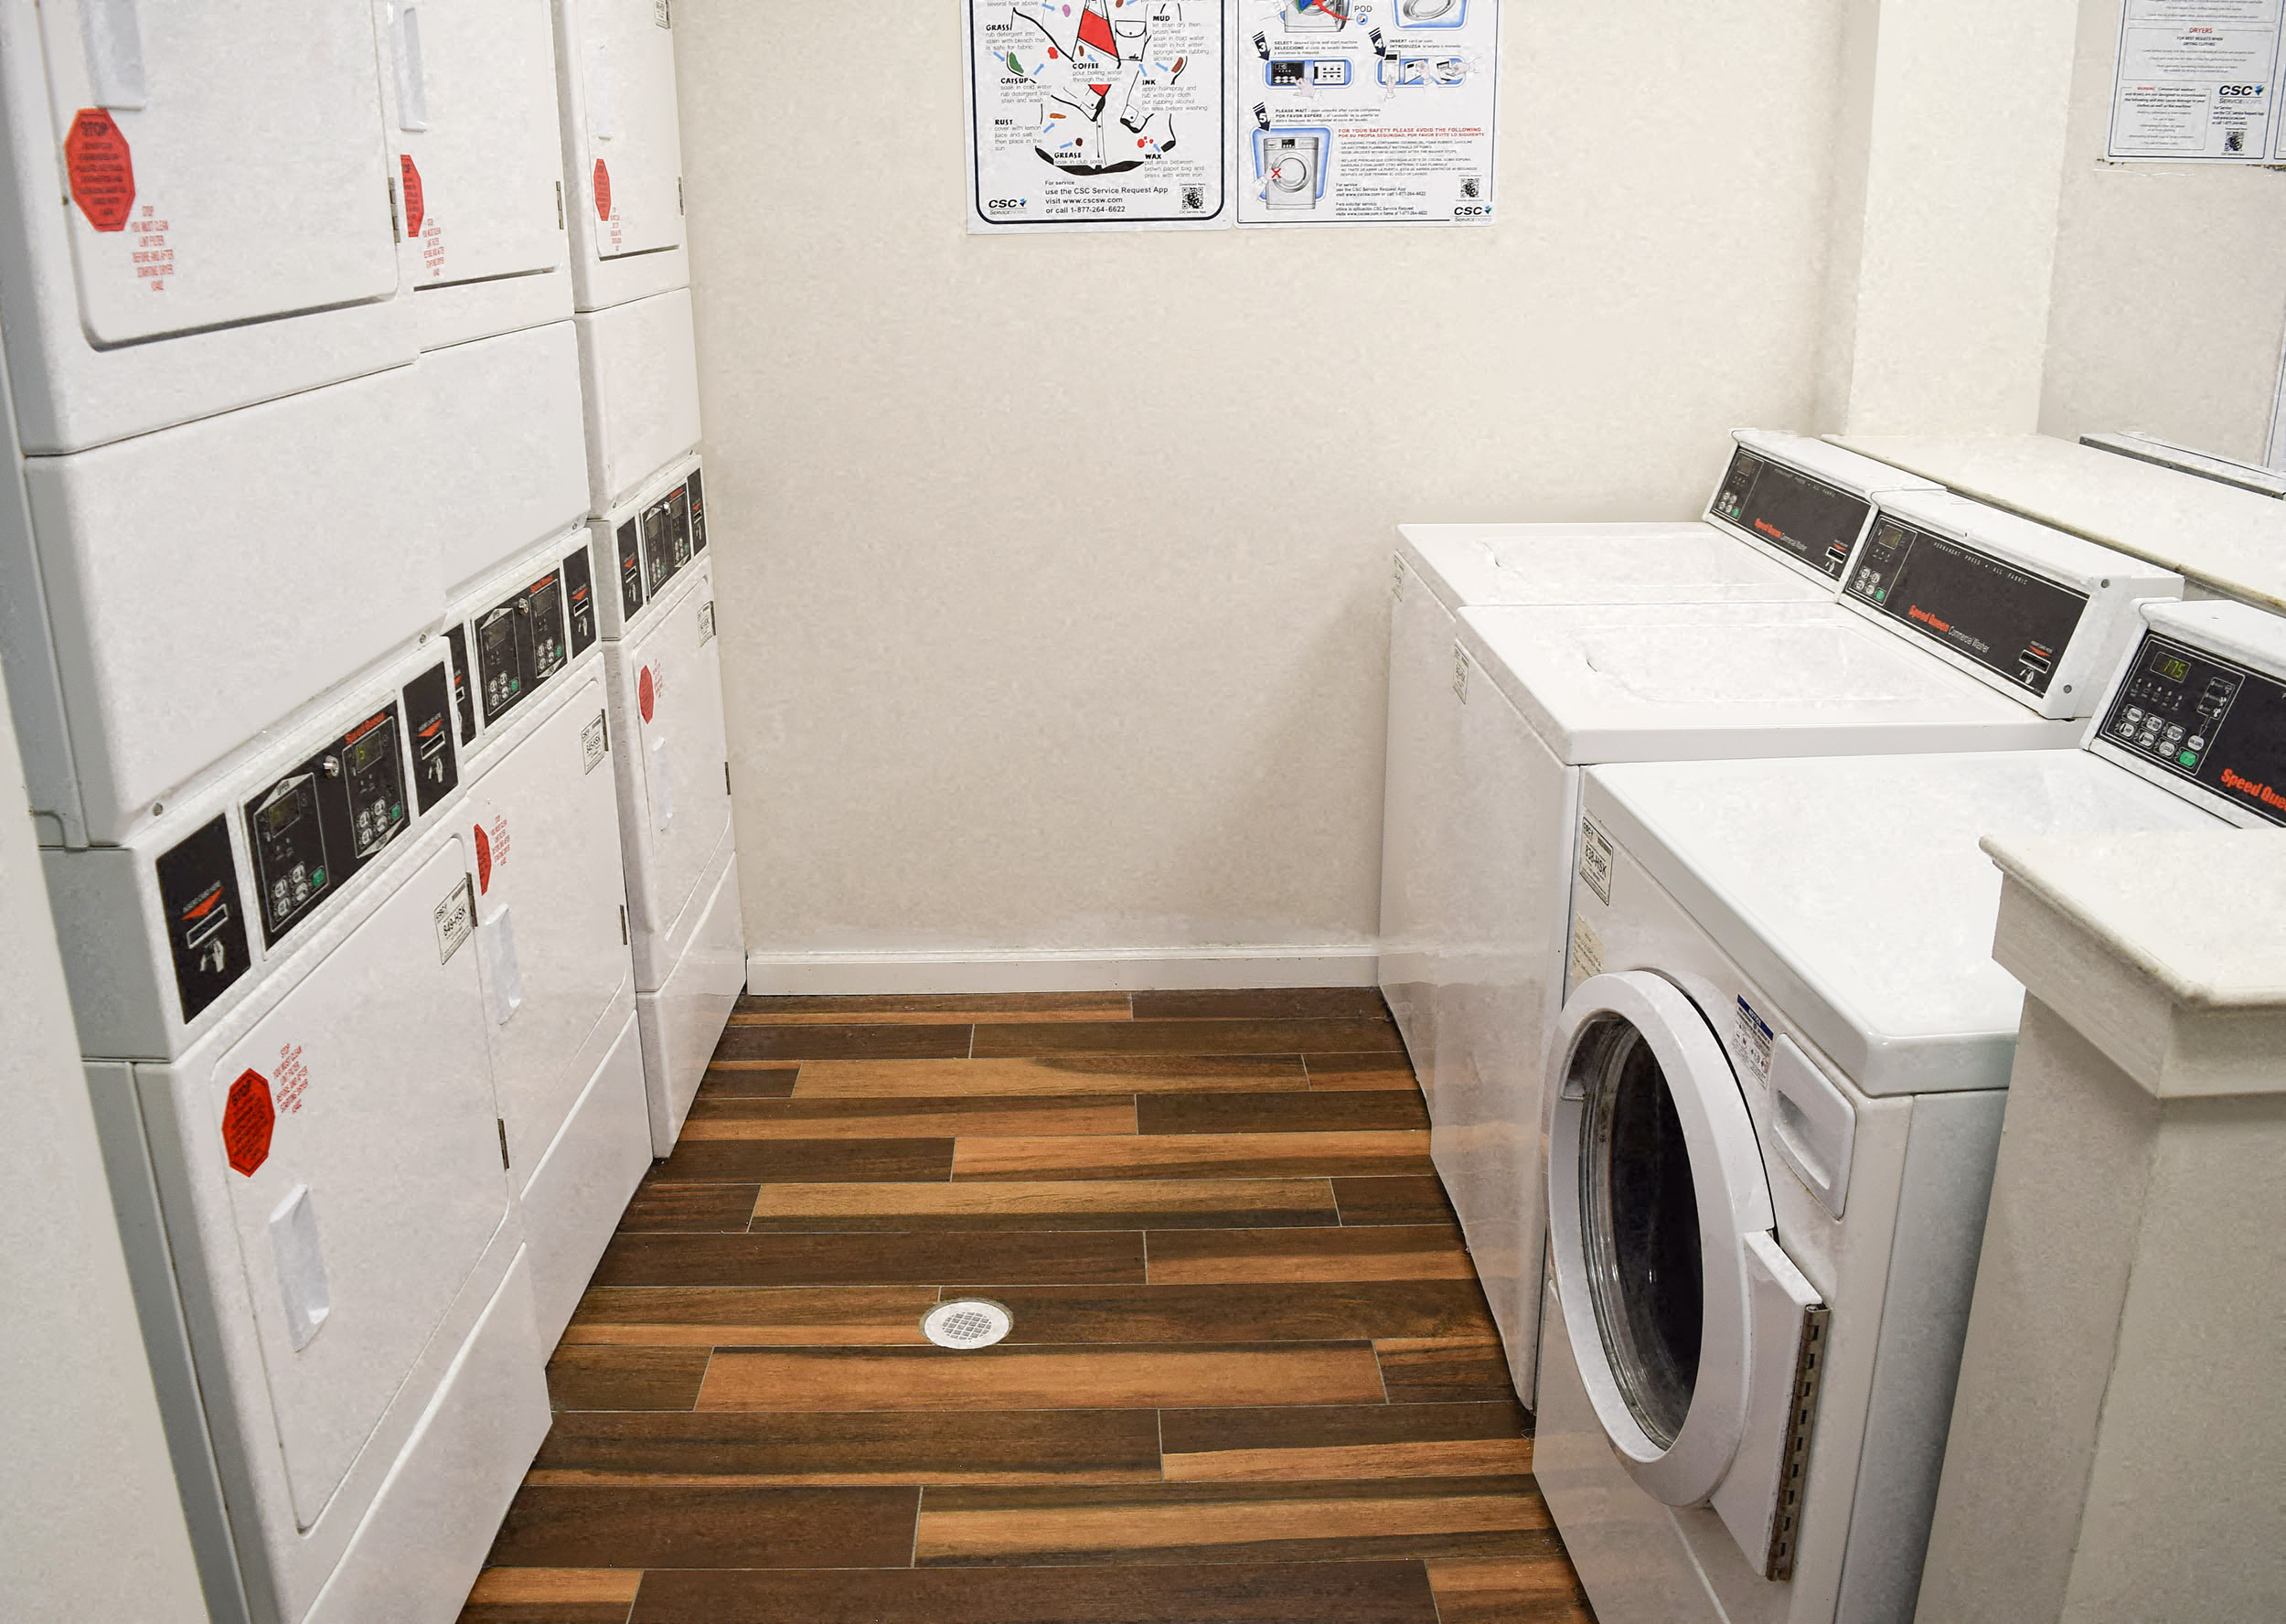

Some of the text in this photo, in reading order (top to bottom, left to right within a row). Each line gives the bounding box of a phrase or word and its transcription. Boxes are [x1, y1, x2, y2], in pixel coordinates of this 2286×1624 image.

[1354, 5, 1372, 13] POD
[1258, 42, 1266, 52] 3
[1374, 38, 1383, 48] 4
[2219, 86, 2252, 95] CSC
[1259, 112, 1266, 123] 5
[80, 122, 107, 136] STOP
[988, 199, 1017, 208] CSC
[1454, 207, 1482, 215] CSC
[1934, 541, 2028, 585] PERMANENT PRESS ALL FABRIC
[1909, 604, 1990, 653] Speed Queen Commercial Washer
[2164, 658, 2186, 678] 175
[2220, 768, 2263, 796] Speed
[1748, 1009, 1761, 1026] NOTICE
